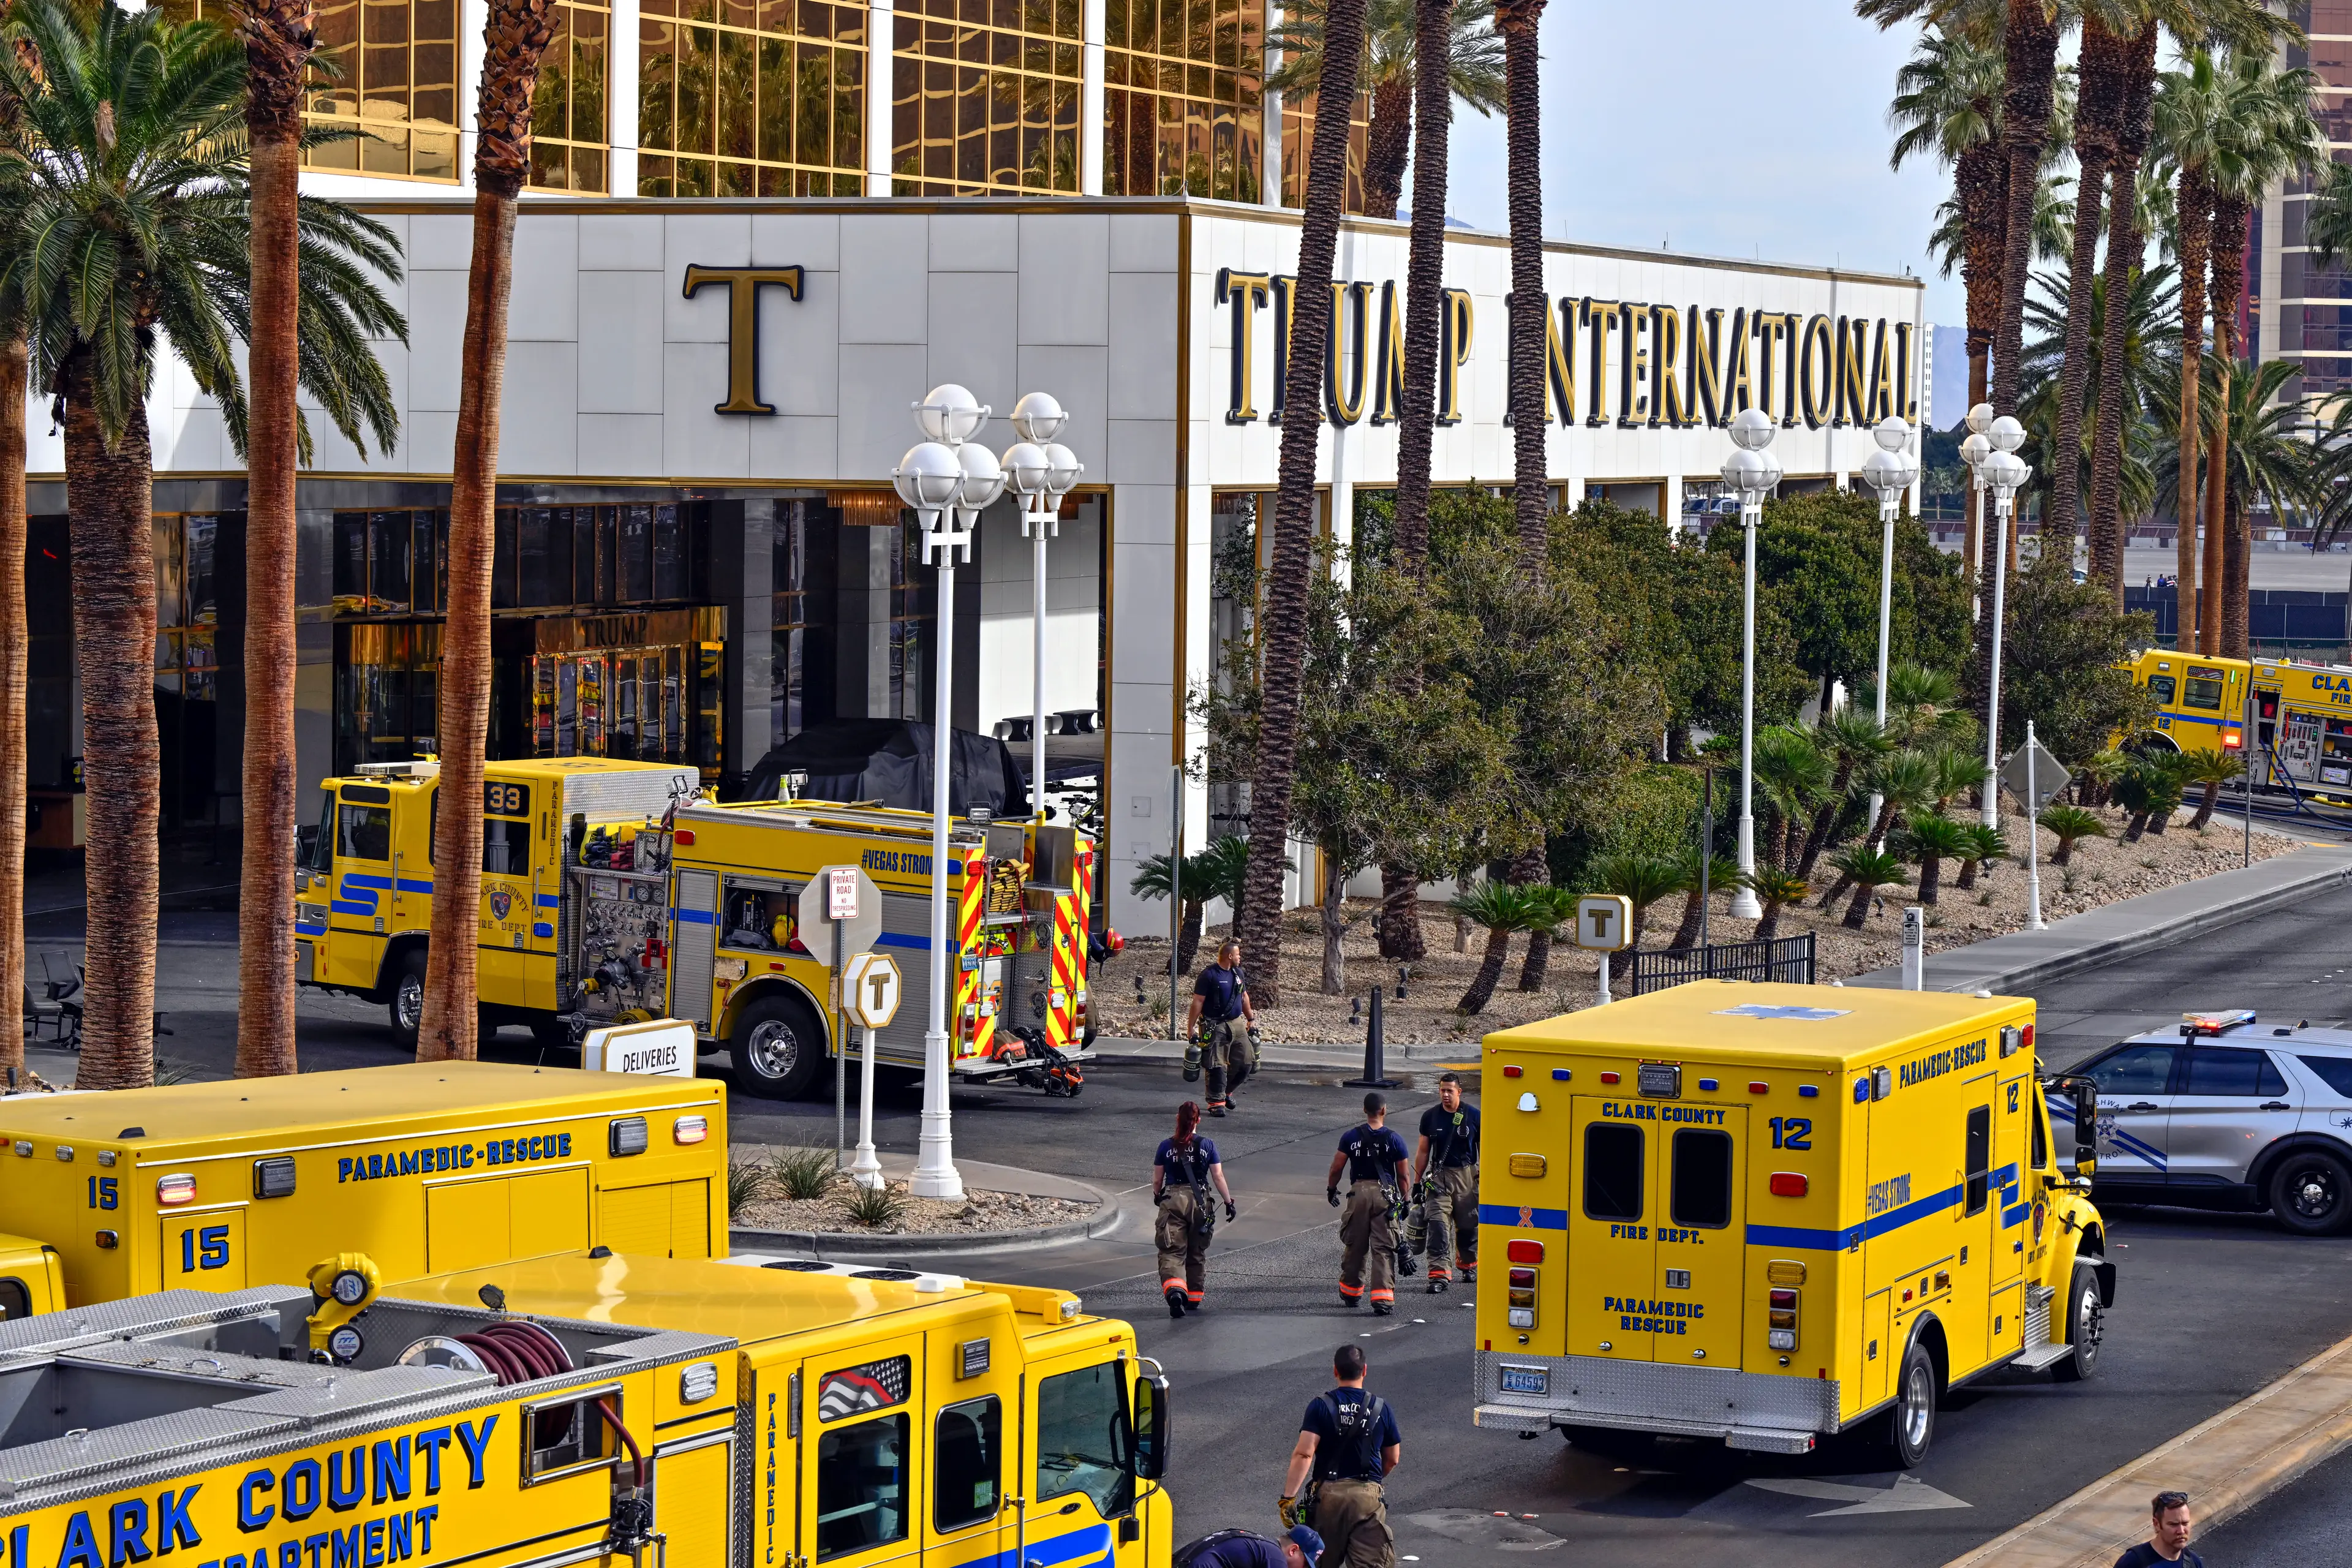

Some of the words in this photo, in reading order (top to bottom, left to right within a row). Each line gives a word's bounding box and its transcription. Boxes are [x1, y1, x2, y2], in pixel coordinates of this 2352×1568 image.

[682, 263, 804, 415] T
[1503, 293, 1918, 430] NTERNATIONAL
[582, 616, 647, 647] TRUMP
[2312, 674, 2352, 691] CLA
[2331, 692, 2352, 704] FIR
[2158, 718, 2171, 729] 12
[491, 786, 520, 810] 33
[862, 849, 899, 872] #VEGAS
[901, 853, 933, 875] STRON
[833, 875, 855, 884] PRIVATE
[500, 883, 529, 912] COUNTY
[1588, 909, 1613, 937] T
[869, 973, 890, 1010] T
[624, 1046, 676, 1072] DELIVERIES
[2007, 1082, 2019, 1115] 12
[1603, 1102, 1657, 1120] CLARK
[1662, 1104, 1725, 1125] COUNTY
[1768, 1117, 1812, 1151] 12
[2100, 1149, 2124, 1159] TROL
[88, 1175, 118, 1210] 15
[1868, 1180, 1888, 1216] #VEGAS
[1890, 1172, 1910, 1208] STRONG
[1611, 1224, 1648, 1240] FIRE
[1657, 1227, 1704, 1244] DEPT.
[179, 1224, 230, 1273] 15
[1604, 1297, 1704, 1318] PARAMEDIC
[1621, 1316, 1686, 1335] RESCUE
[1515, 1376, 1544, 1390] 64593
[238, 1414, 500, 1533] COUNTY
[766, 1392, 776, 1564] PARAMEDIC
